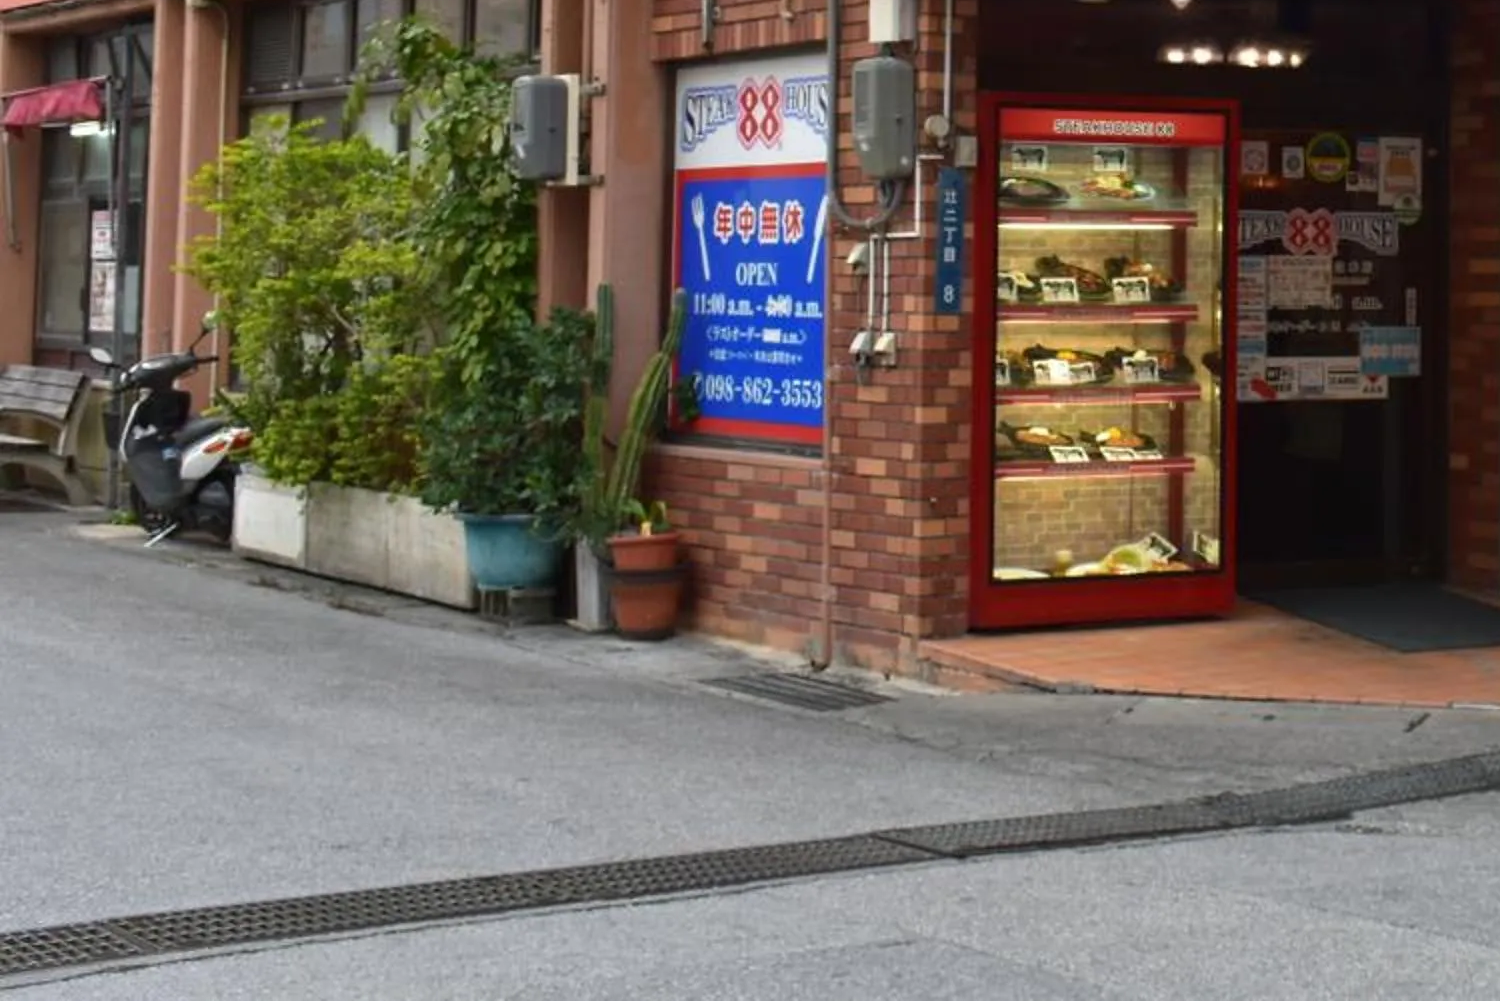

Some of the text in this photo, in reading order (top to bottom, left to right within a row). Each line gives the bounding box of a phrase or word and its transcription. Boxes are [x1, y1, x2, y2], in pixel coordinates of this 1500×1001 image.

[740, 85, 779, 142] 88
[784, 82, 830, 128] HOUS
[714, 200, 804, 244] 年中無休
[1239, 214, 1288, 248] TEAK
[1287, 210, 1336, 253] 88
[943, 188, 959, 304] 辻二丁目 8
[735, 262, 779, 287] OPEN
[705, 374, 822, 410] 098-862-3553
